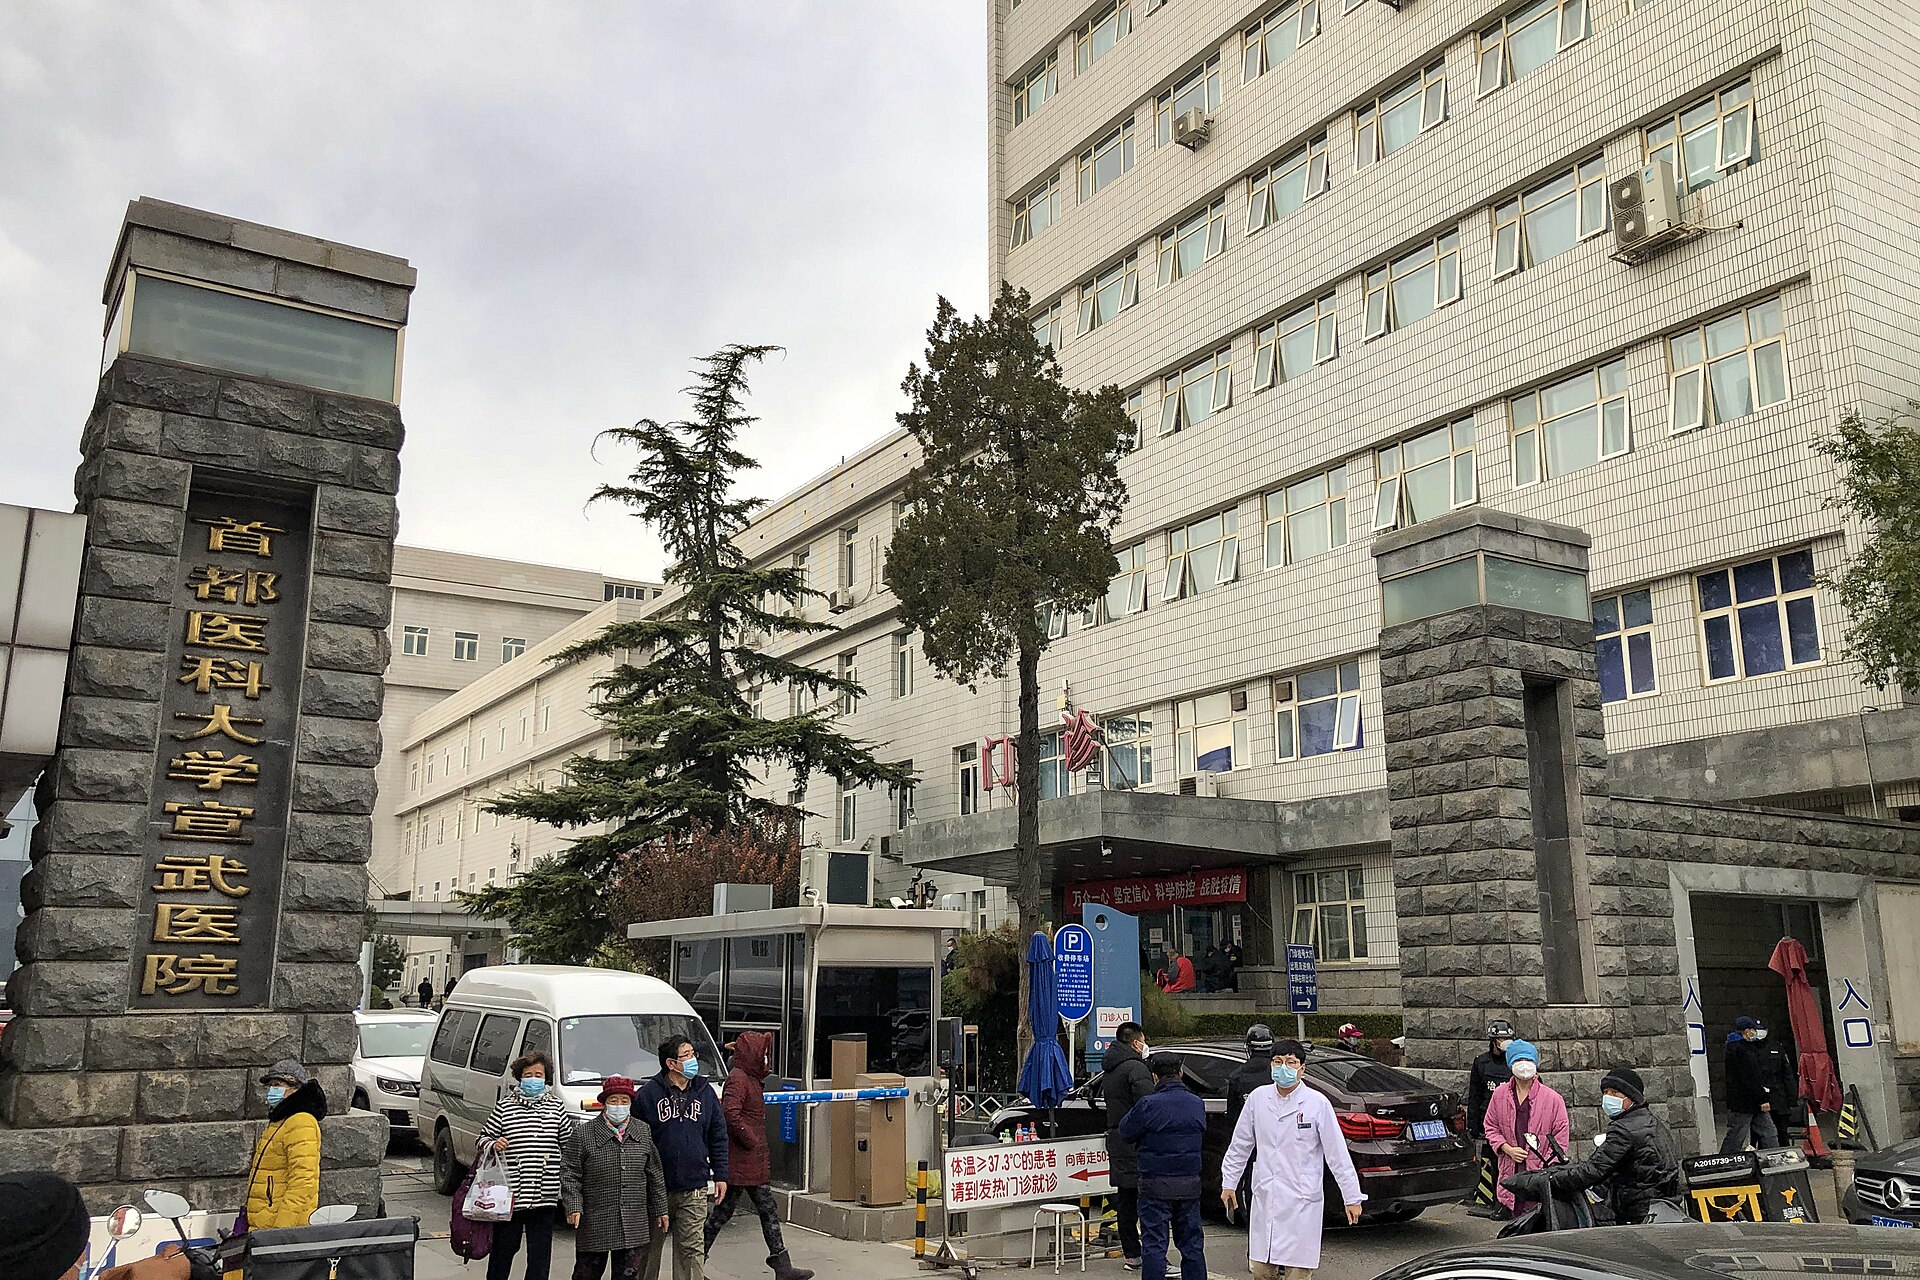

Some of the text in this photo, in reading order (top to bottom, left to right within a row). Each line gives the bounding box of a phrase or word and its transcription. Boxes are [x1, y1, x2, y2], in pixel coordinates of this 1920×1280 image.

[141, 516, 287, 996] 首都医科大学宣武医院
[1072, 874, 1241, 907] 万众一心 坚定信心 科学防控 战胜疫情
[1058, 954, 1090, 963] 收费停车场
[1100, 1012, 1130, 1022] 门诊入口
[1838, 977, 1873, 1048] 入口
[1065, 1151, 1109, 1167] 向南走50
[951, 1172, 1058, 1203] 请到发热门诊就诊
